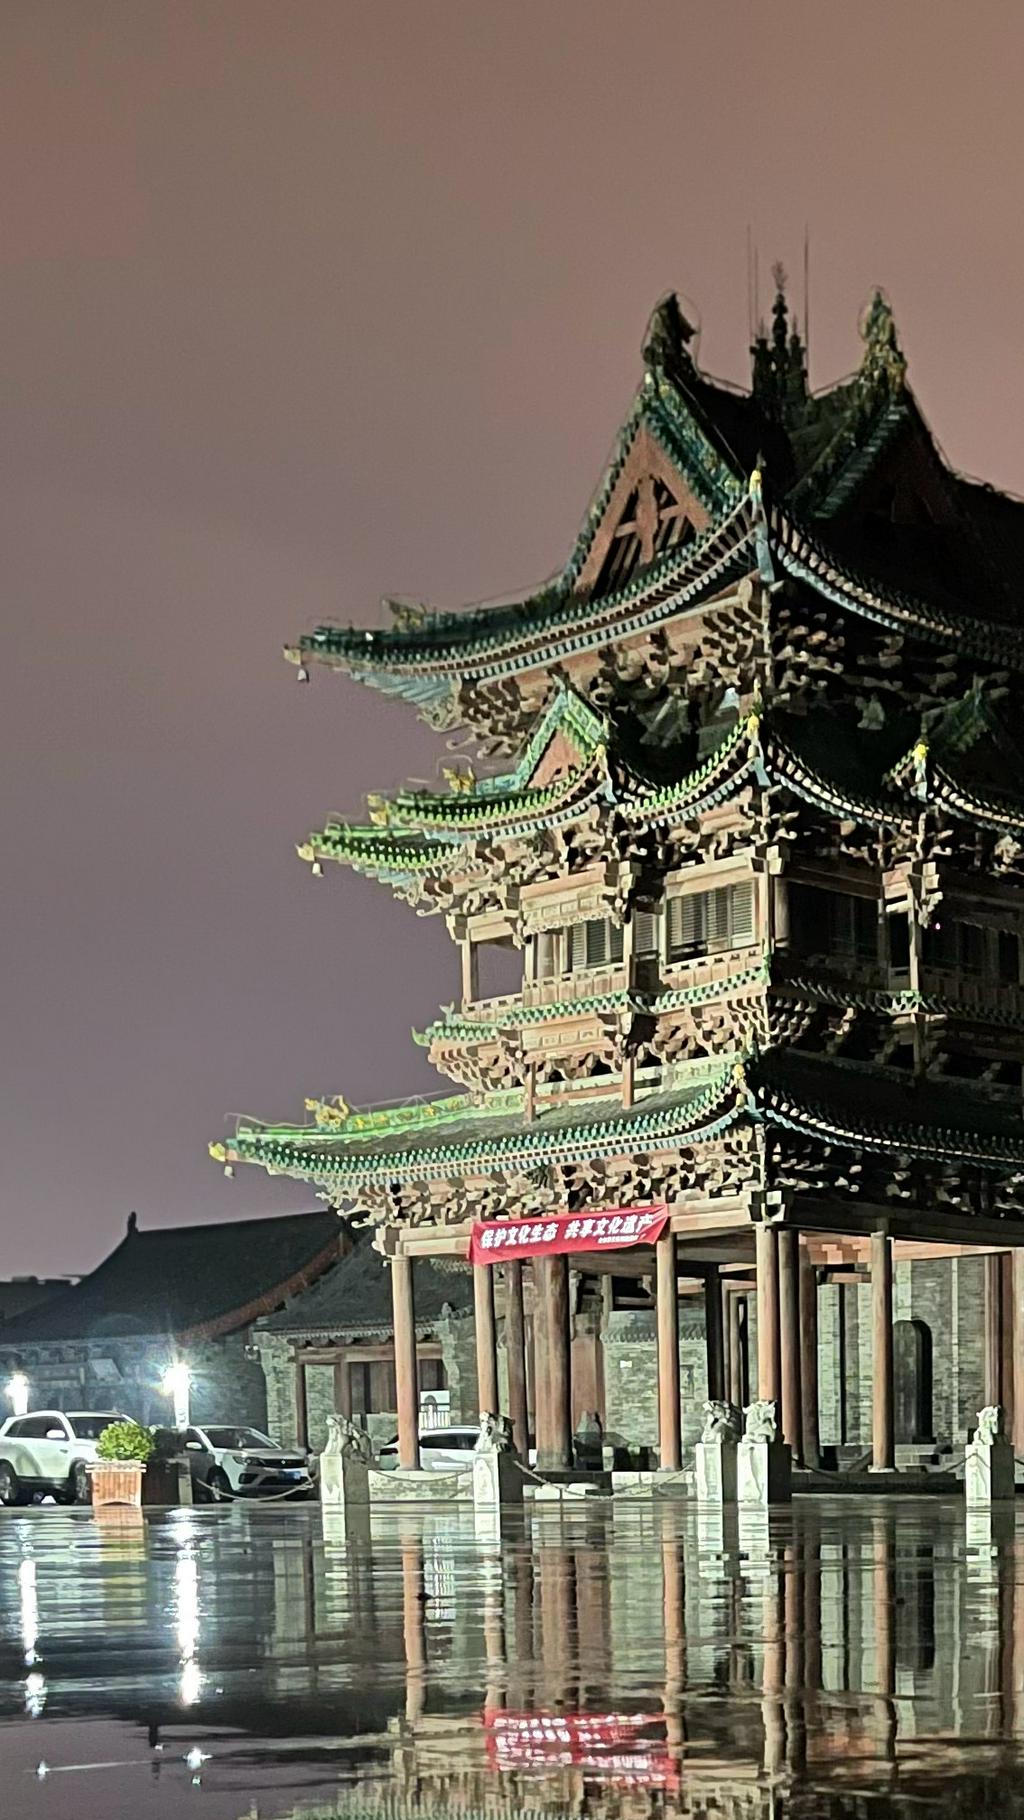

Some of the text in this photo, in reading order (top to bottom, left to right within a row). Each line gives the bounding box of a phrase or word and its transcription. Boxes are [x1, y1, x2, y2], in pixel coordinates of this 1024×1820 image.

[481, 1222, 559, 1249] 保护文化生态
[564, 1213, 654, 1240] 共享文化遗产
